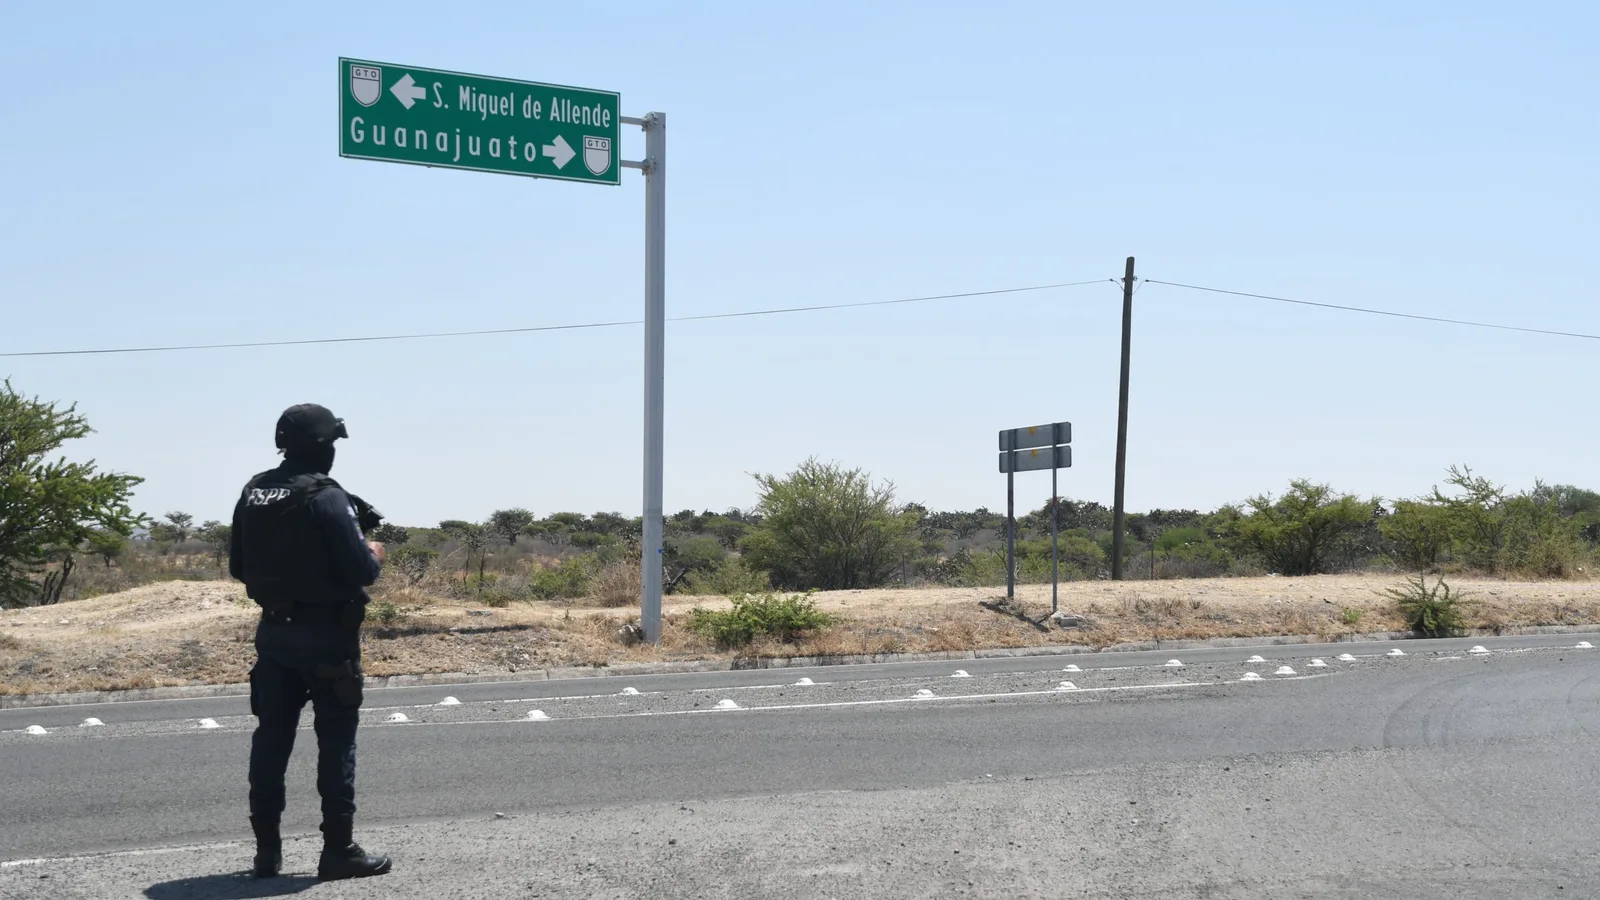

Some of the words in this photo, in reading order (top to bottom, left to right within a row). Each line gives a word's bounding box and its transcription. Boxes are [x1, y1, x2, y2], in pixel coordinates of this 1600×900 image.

[355, 68, 378, 79] GTO
[433, 82, 449, 109] S.
[459, 85, 515, 121] Miguel
[522, 94, 541, 120] de
[549, 96, 611, 129] Allende
[350, 116, 537, 162] Guanajuato
[587, 139, 607, 149] GTO
